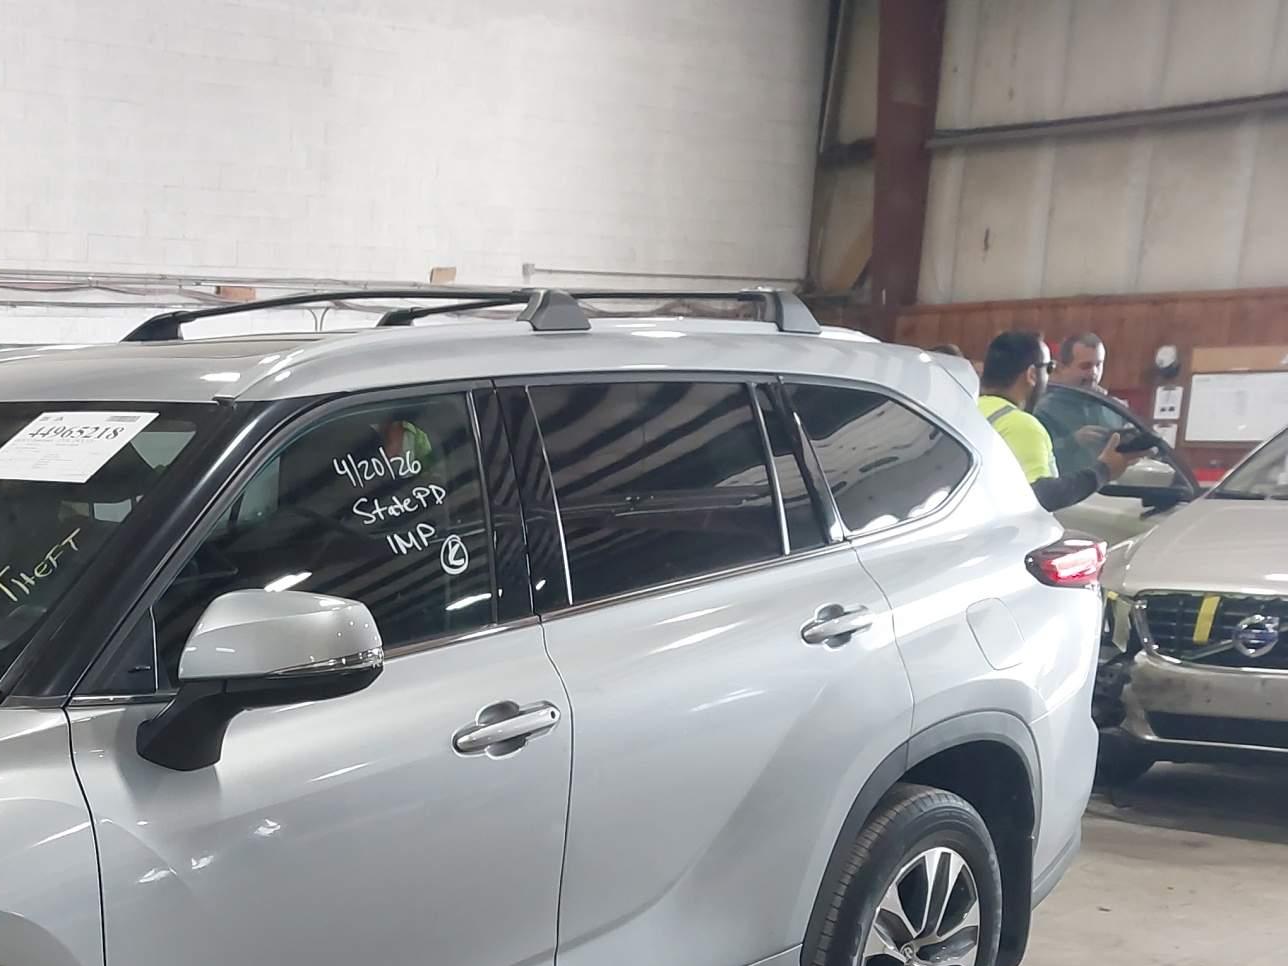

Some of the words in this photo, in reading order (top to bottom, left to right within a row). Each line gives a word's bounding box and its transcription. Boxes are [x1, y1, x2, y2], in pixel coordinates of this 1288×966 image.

[29, 426, 125, 440] 44965218
[333, 447, 422, 487] 4/20/26
[386, 523, 435, 555] IMP
